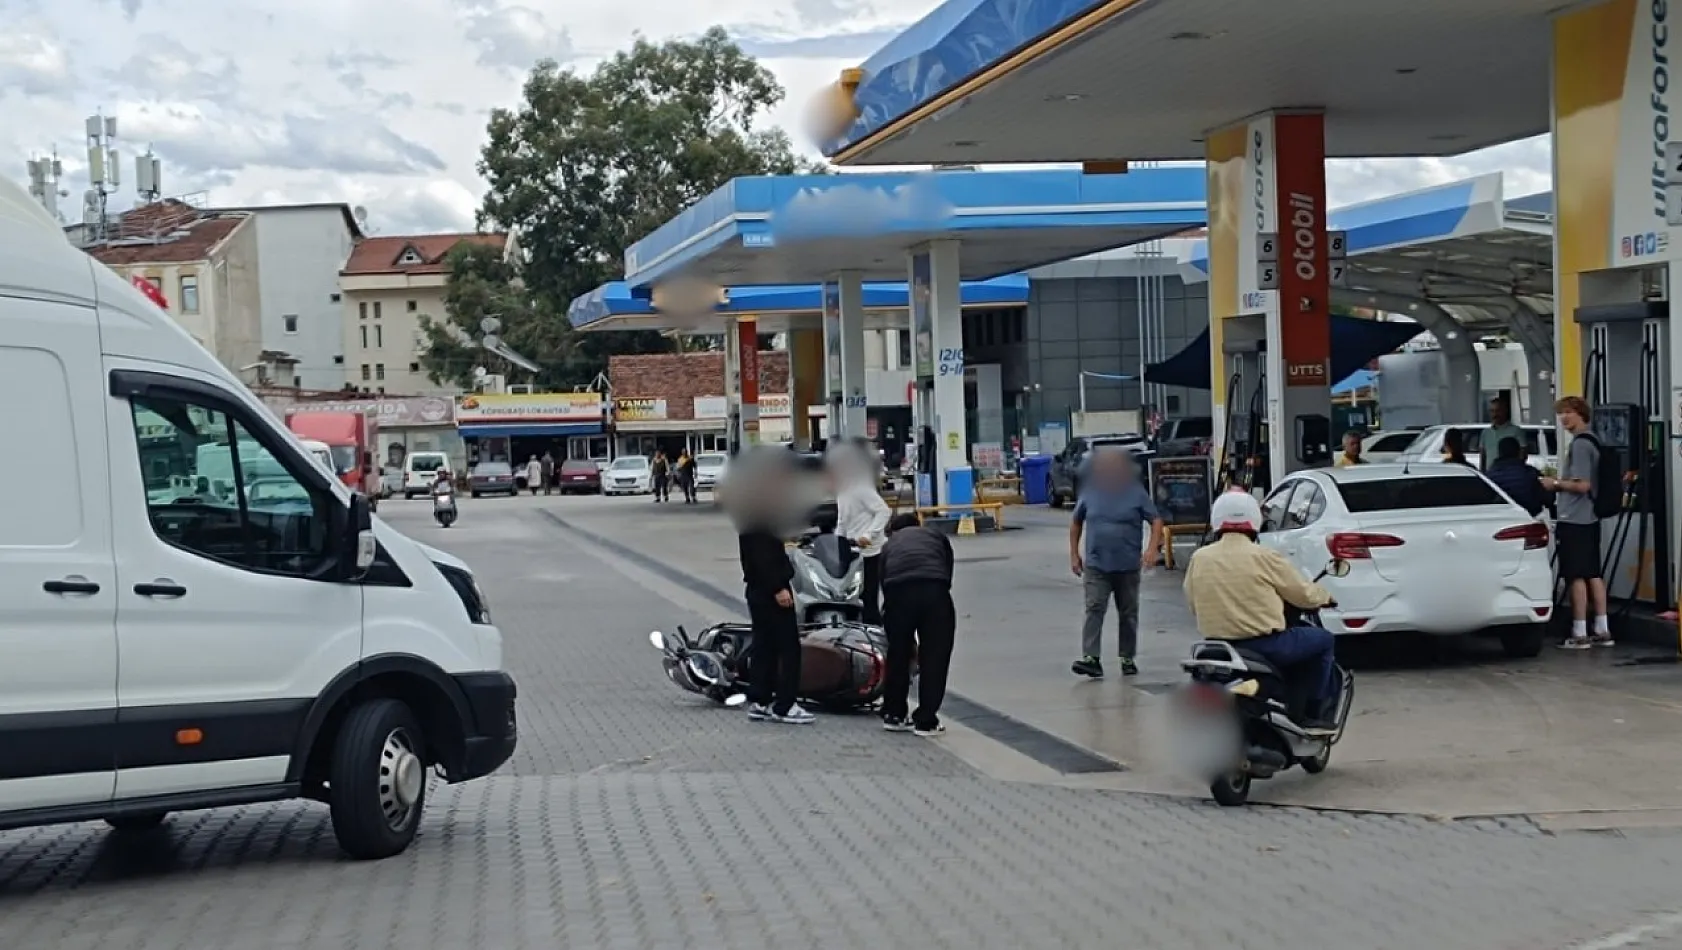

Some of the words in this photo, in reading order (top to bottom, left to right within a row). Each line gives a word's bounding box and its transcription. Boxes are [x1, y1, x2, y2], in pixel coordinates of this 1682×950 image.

[1254, 131, 1265, 231] aforce
[1289, 192, 1316, 280] otobil
[1263, 240, 1273, 253] 6
[1332, 238, 1343, 250] 8
[1263, 269, 1273, 282] 5
[1333, 267, 1343, 280] 7
[1289, 364, 1324, 376] UTTS
